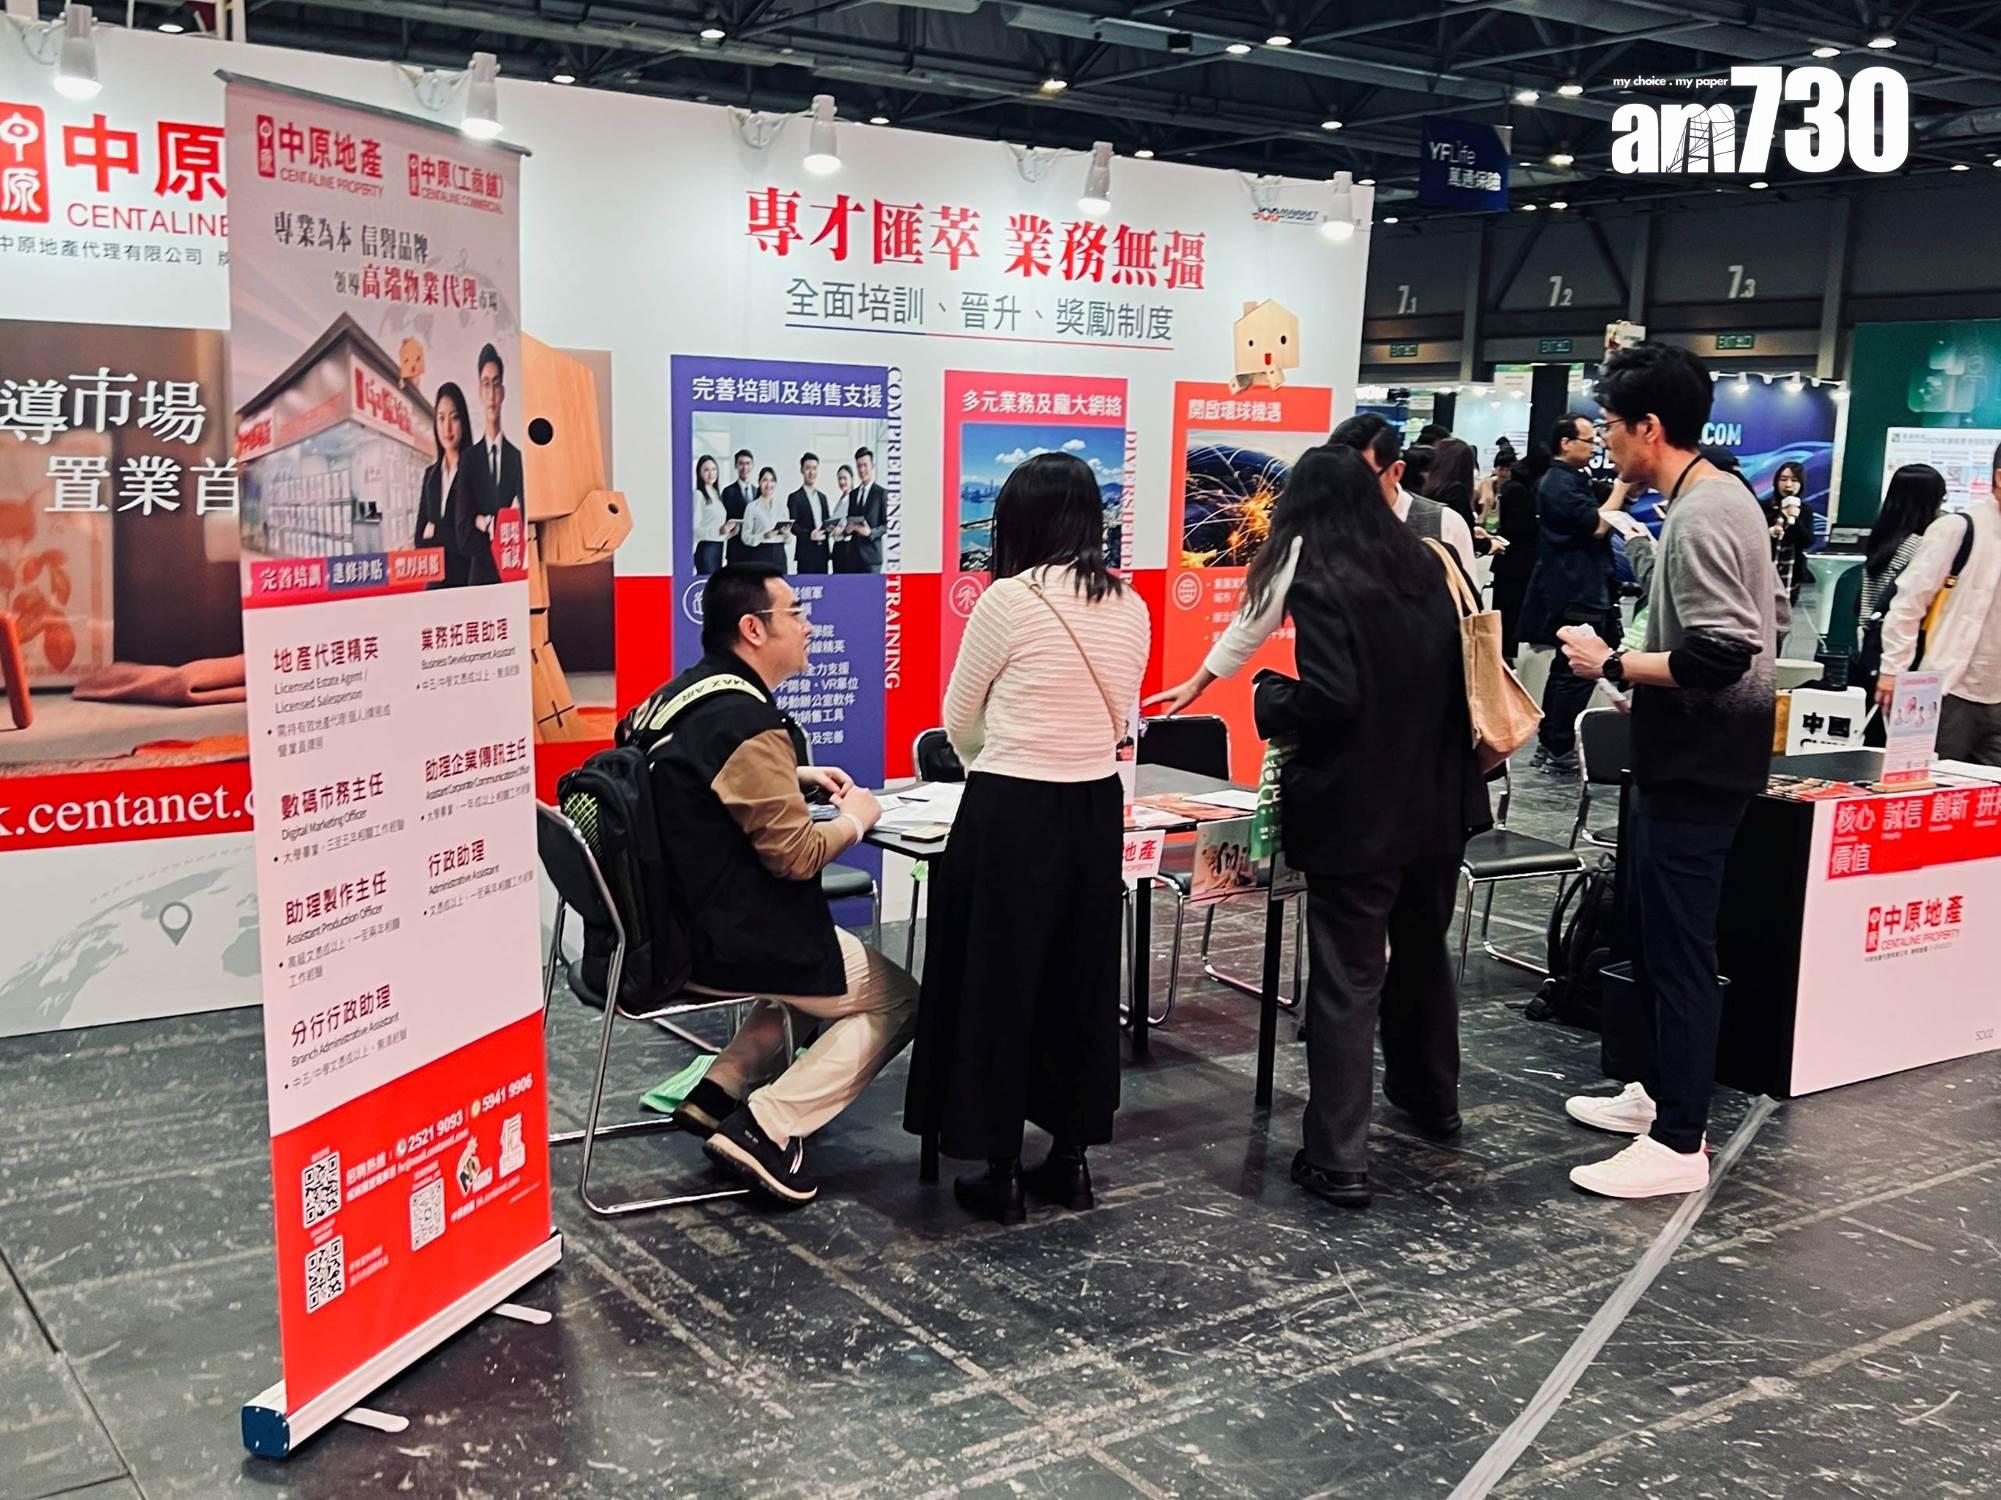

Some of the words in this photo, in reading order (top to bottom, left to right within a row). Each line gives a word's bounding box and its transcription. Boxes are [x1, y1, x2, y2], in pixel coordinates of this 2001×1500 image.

[61, 113, 227, 202] 中原
[279, 121, 385, 180] 中原地產
[280, 166, 335, 190] CENTALINE
[337, 177, 385, 199] PROPERTY
[67, 202, 229, 238] CENTALINE
[273, 210, 353, 253] 專業為本
[361, 223, 430, 265] 信譽品牌
[0, 233, 203, 266] 中原地產代理有限公司
[785, 277, 1175, 342] 全面培訓、晉升、獎勵制度
[0, 366, 208, 446] 導市場
[691, 375, 884, 410] 完善培訓及銷售支援
[961, 388, 1123, 417] 多元業務及龐大網絡
[44, 455, 240, 516] 置業首
[885, 366, 903, 572] COMPREHENSIVE
[273, 636, 379, 673] 地產代理精英
[421, 617, 509, 652] 業務拓展助理
[884, 575, 902, 690] TRAINING
[274, 677, 316, 696] Licensed
[275, 695, 317, 715] Licensed
[425, 736, 527, 783] 助理企業傳訊主任
[281, 771, 384, 822] 數碼市務主任
[1835, 802, 1877, 835] 核心
[1880, 799, 1925, 831] 誠信
[1929, 790, 1970, 823] 創新
[428, 838, 486, 879] 行政助理
[1831, 843, 1872, 876] 價值
[285, 869, 388, 927] 助理製作主任
[1883, 894, 1964, 936] 中原地產
[290, 983, 392, 1048] 分行行政助理
[407, 1123, 434, 1154] 2521
[436, 1108, 464, 1137] 9093
